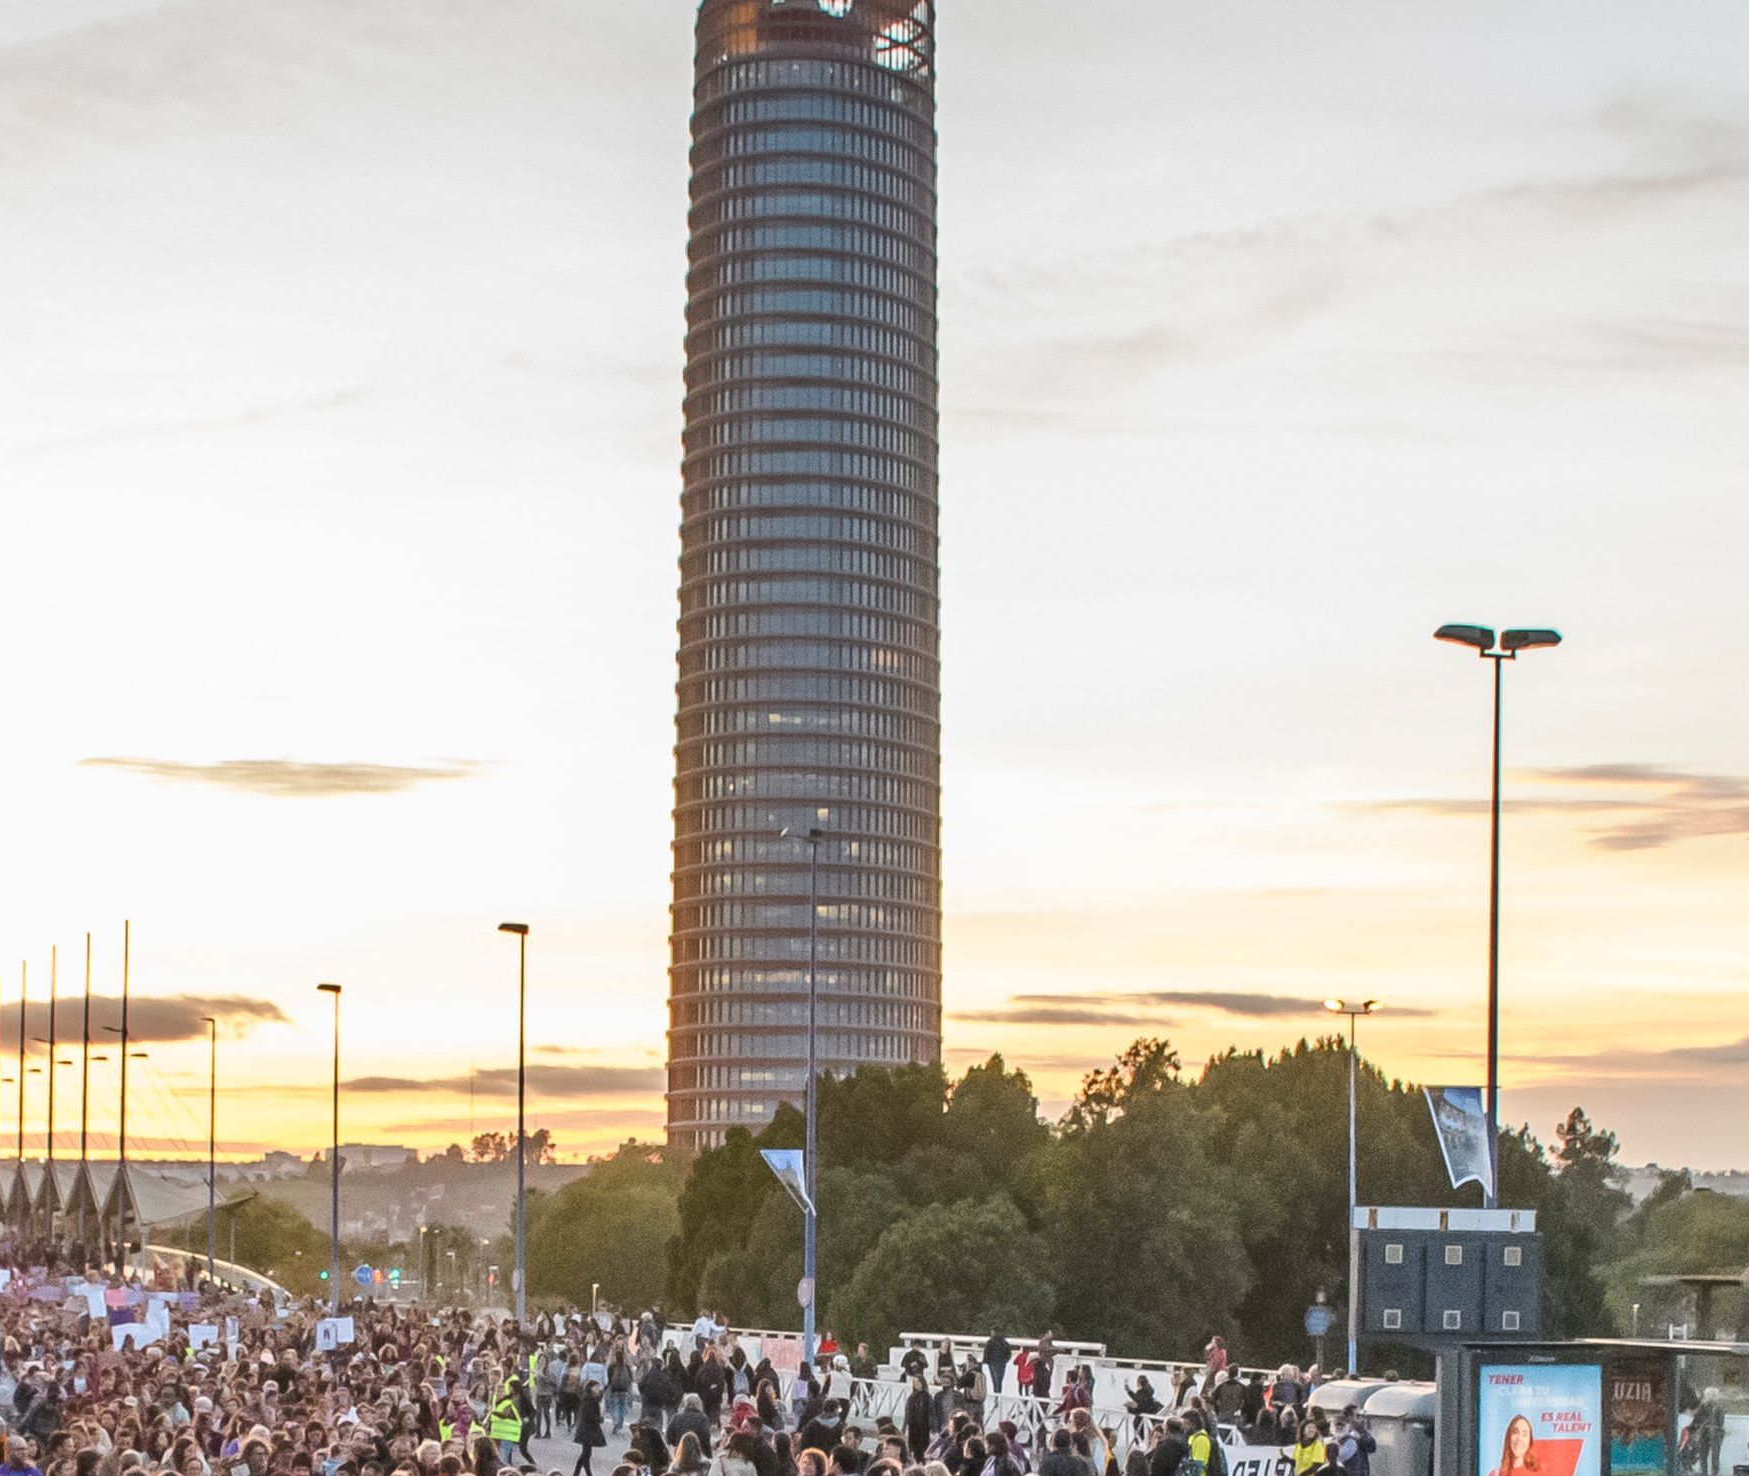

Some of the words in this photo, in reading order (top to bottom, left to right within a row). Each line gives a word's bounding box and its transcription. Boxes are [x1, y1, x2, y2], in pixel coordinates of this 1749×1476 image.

[1488, 1374, 1524, 1385] TENER
[1541, 1412, 1553, 1421] ES
[1555, 1412, 1583, 1422] REAL
[1551, 1422, 1593, 1433] TALENT
